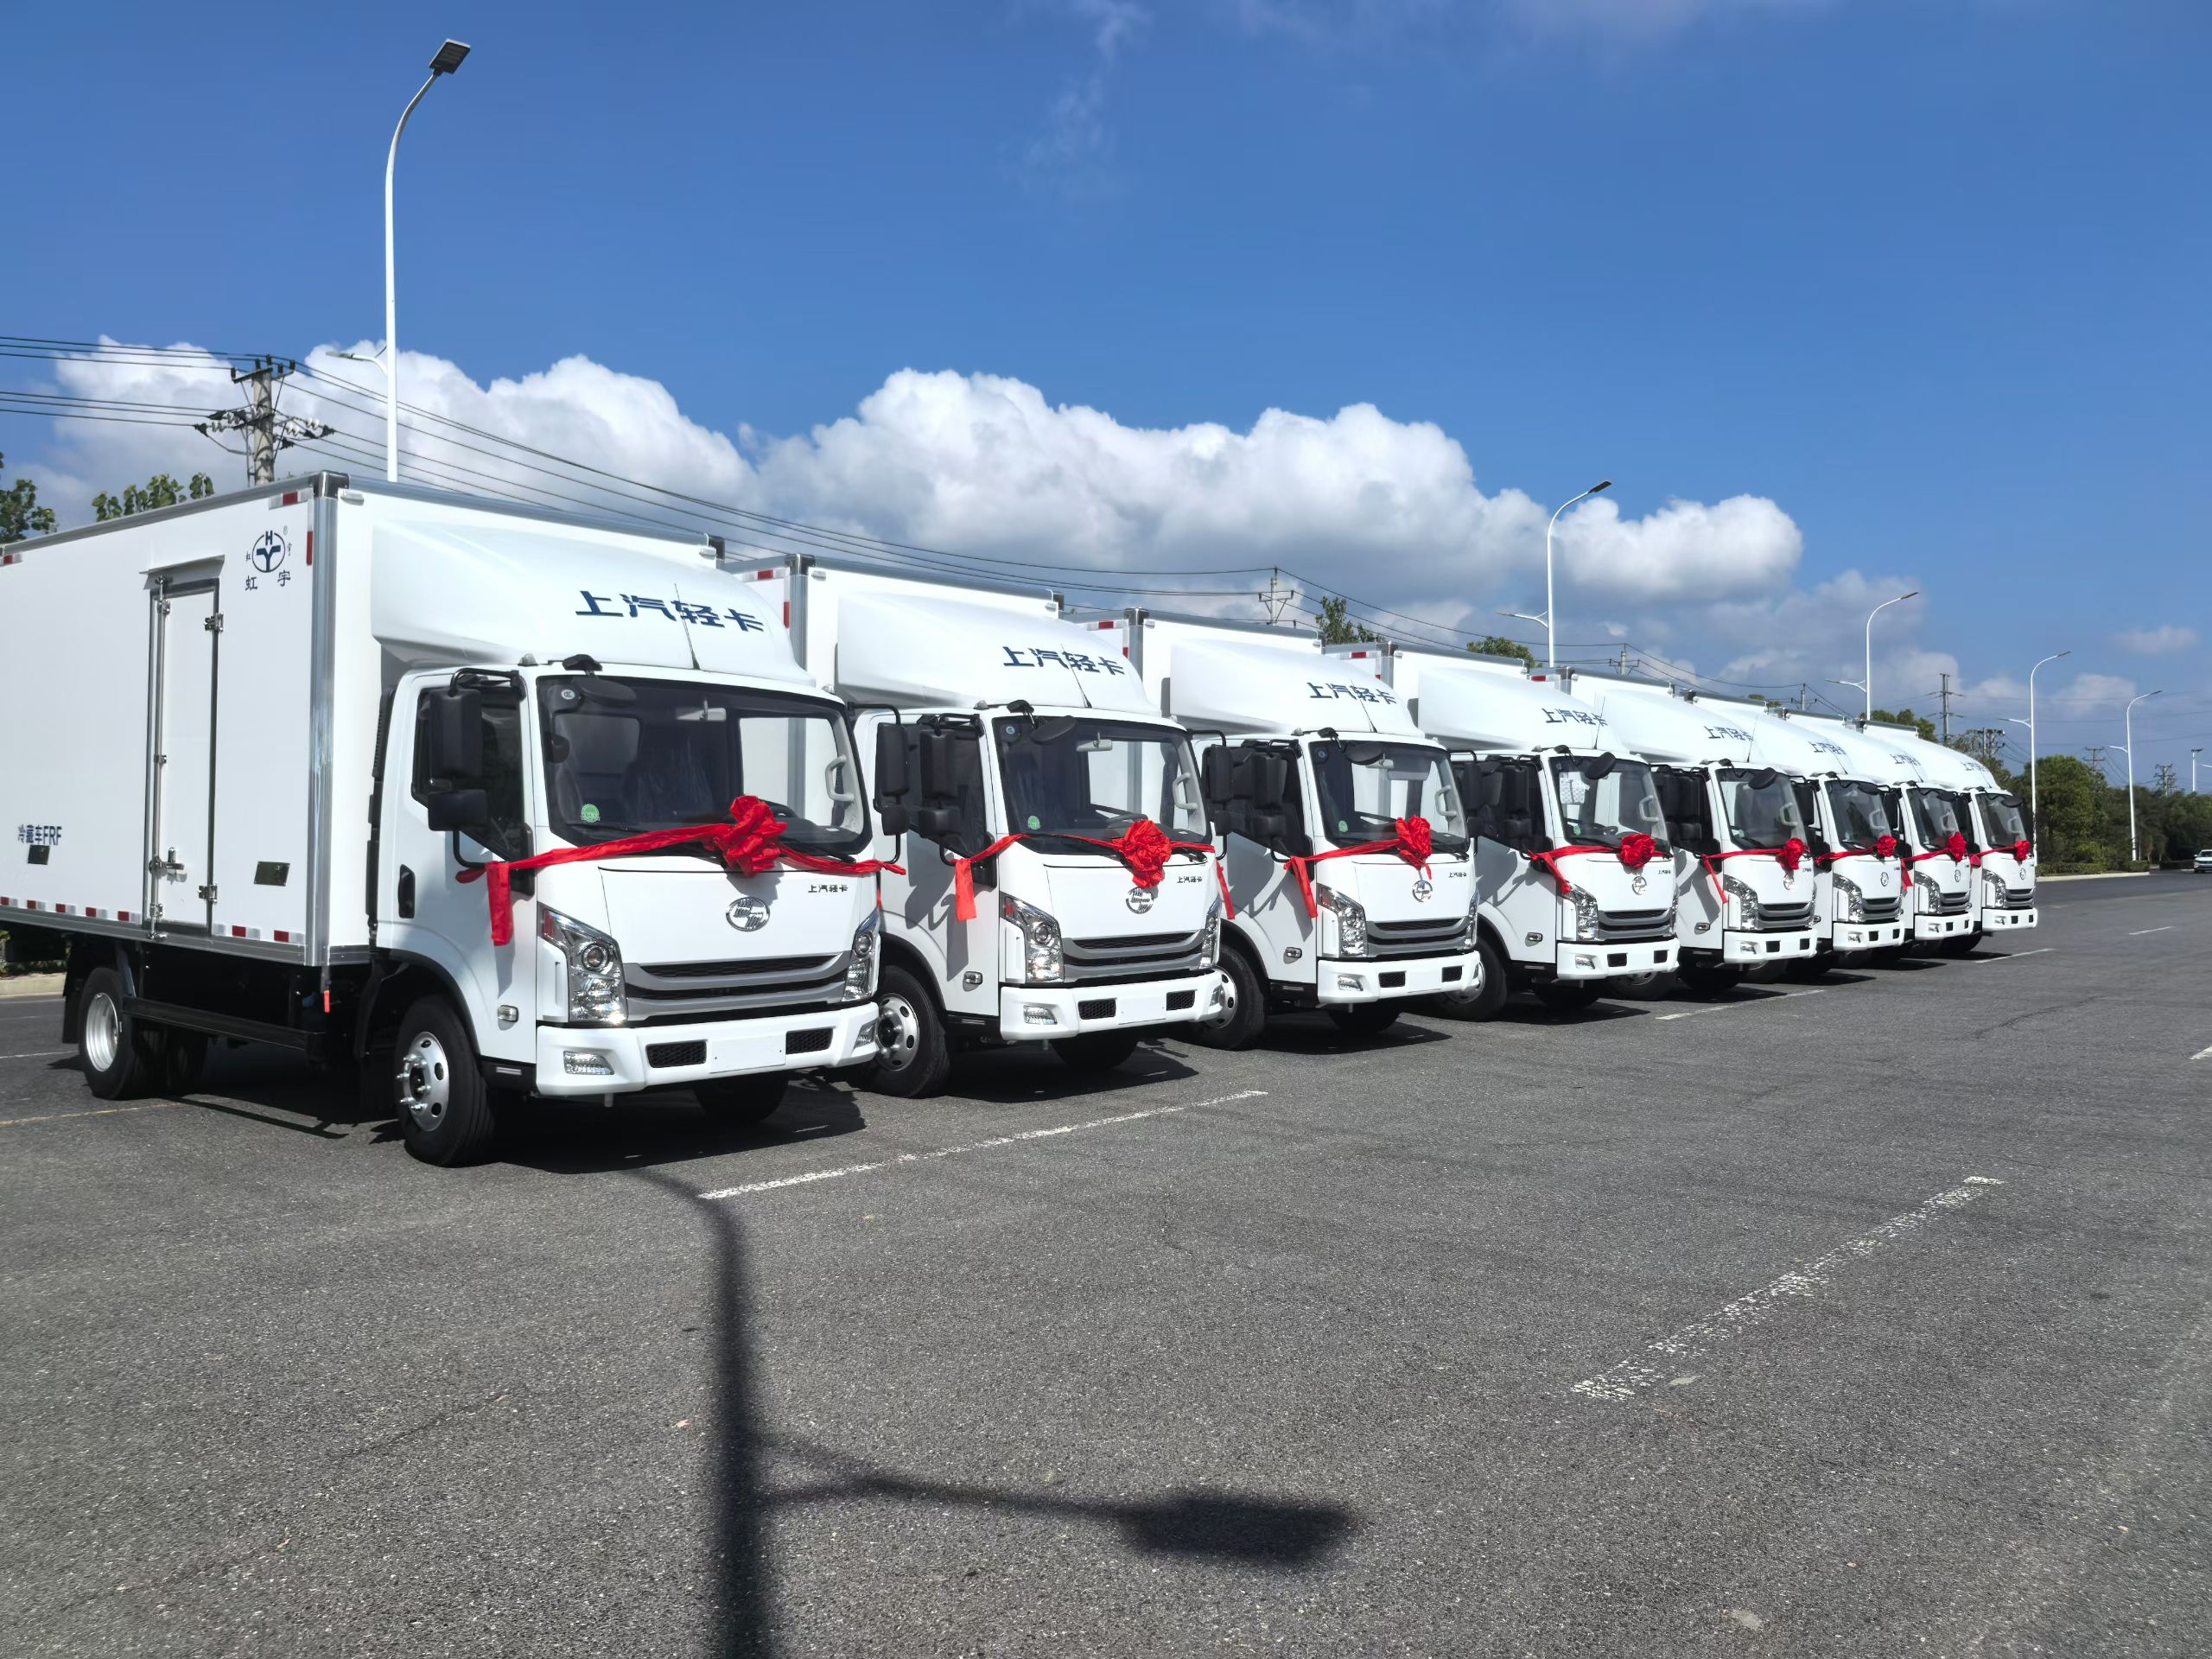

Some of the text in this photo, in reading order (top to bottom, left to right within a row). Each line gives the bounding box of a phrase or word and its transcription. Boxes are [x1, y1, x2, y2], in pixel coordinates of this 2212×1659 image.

[245, 569, 291, 591] 虹宇
[575, 590, 764, 632] 上汽轻卡
[1002, 646, 1125, 676] 上汽轻卡
[1306, 682, 1397, 704] 上汽轻卡
[1541, 708, 1609, 727] 上汽轻卡
[808, 884, 849, 893] 上汽轻卡
